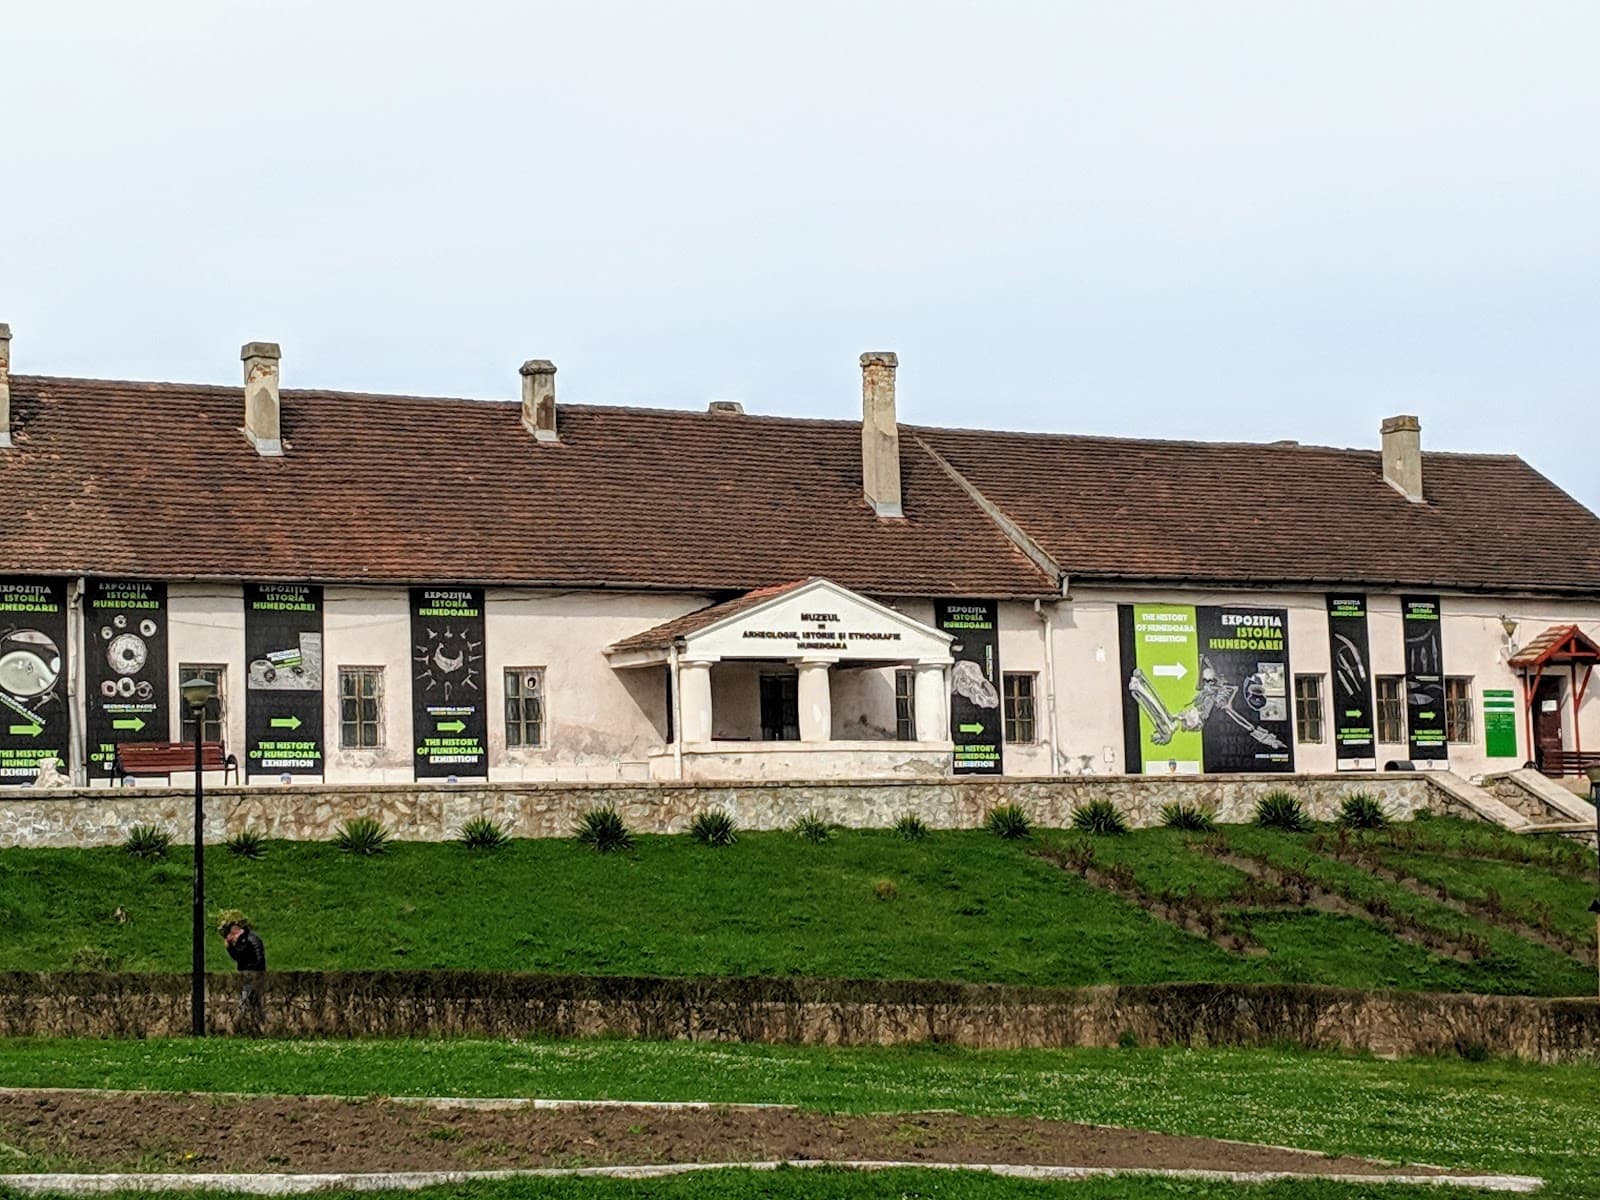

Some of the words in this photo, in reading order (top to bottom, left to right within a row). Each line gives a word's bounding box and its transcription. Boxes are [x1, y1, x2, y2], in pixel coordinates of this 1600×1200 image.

[0, 585, 52, 594] XPOZIȚIA
[4, 594, 46, 603] ISTORIA
[107, 592, 148, 600] ISTORIA
[0, 603, 58, 612] UNEDOAREI
[93, 600, 159, 609] HUNEDOAREI
[252, 602, 316, 611] HUNEDOAREI
[432, 600, 468, 608] ISTORIA
[419, 608, 478, 616] HUNEDOAREI
[801, 613, 840, 622] MUZEUL
[742, 631, 800, 641] ARHEOLOGIE,
[802, 632, 835, 640] ISTORIE
[848, 632, 901, 640] ETNOGRAFIE
[1237, 628, 1283, 638] ISTORIA
[797, 642, 847, 650] HUNEDOARA
[1209, 639, 1283, 650] HUNEDOAREI
[258, 742, 275, 750] THE
[276, 742, 316, 750] HISTORY
[424, 738, 440, 746] THE
[442, 738, 479, 746] HISTORY
[16, 750, 59, 758] HISTORY
[264, 751, 321, 759] HUNEDOARA
[416, 747, 429, 755] OF
[262, 759, 314, 767] EXHIBITION
[1, 768, 41, 776] EXHIBIT
